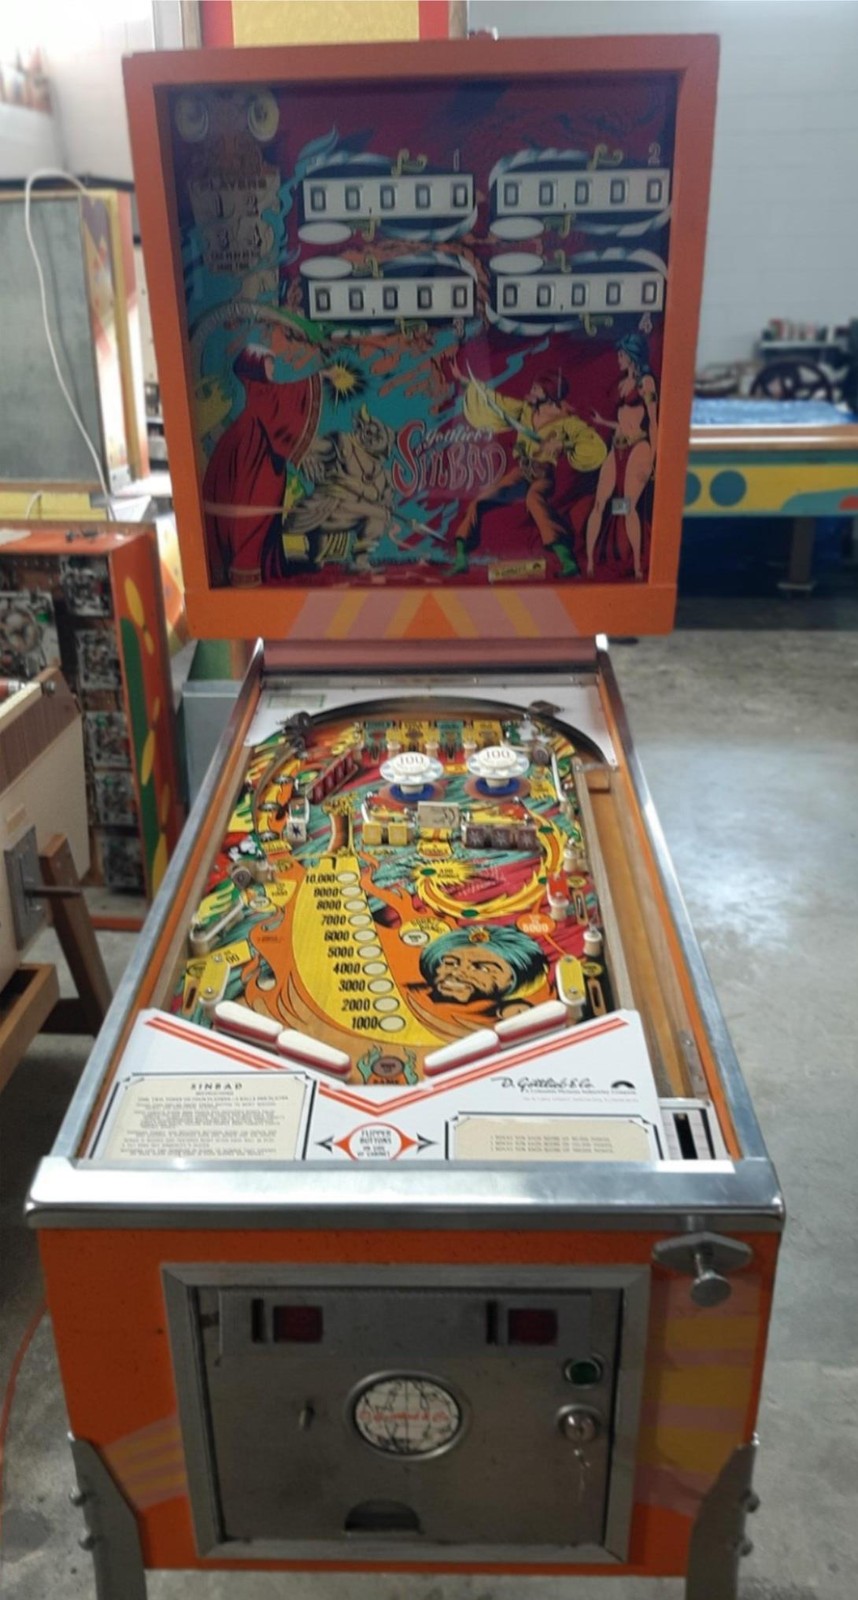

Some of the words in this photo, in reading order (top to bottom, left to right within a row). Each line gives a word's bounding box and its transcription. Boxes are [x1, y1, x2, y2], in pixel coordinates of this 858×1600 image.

[648, 143, 661, 166] 2
[314, 888, 339, 897] 9000
[316, 901, 342, 910] 8000
[321, 915, 347, 925] 7000
[324, 931, 350, 941] 6000
[328, 947, 354, 958] 5000
[333, 963, 361, 975] 4000
[338, 979, 366, 992] 3000
[341, 999, 370, 1012] 2000
[351, 1016, 378, 1030] 1000
